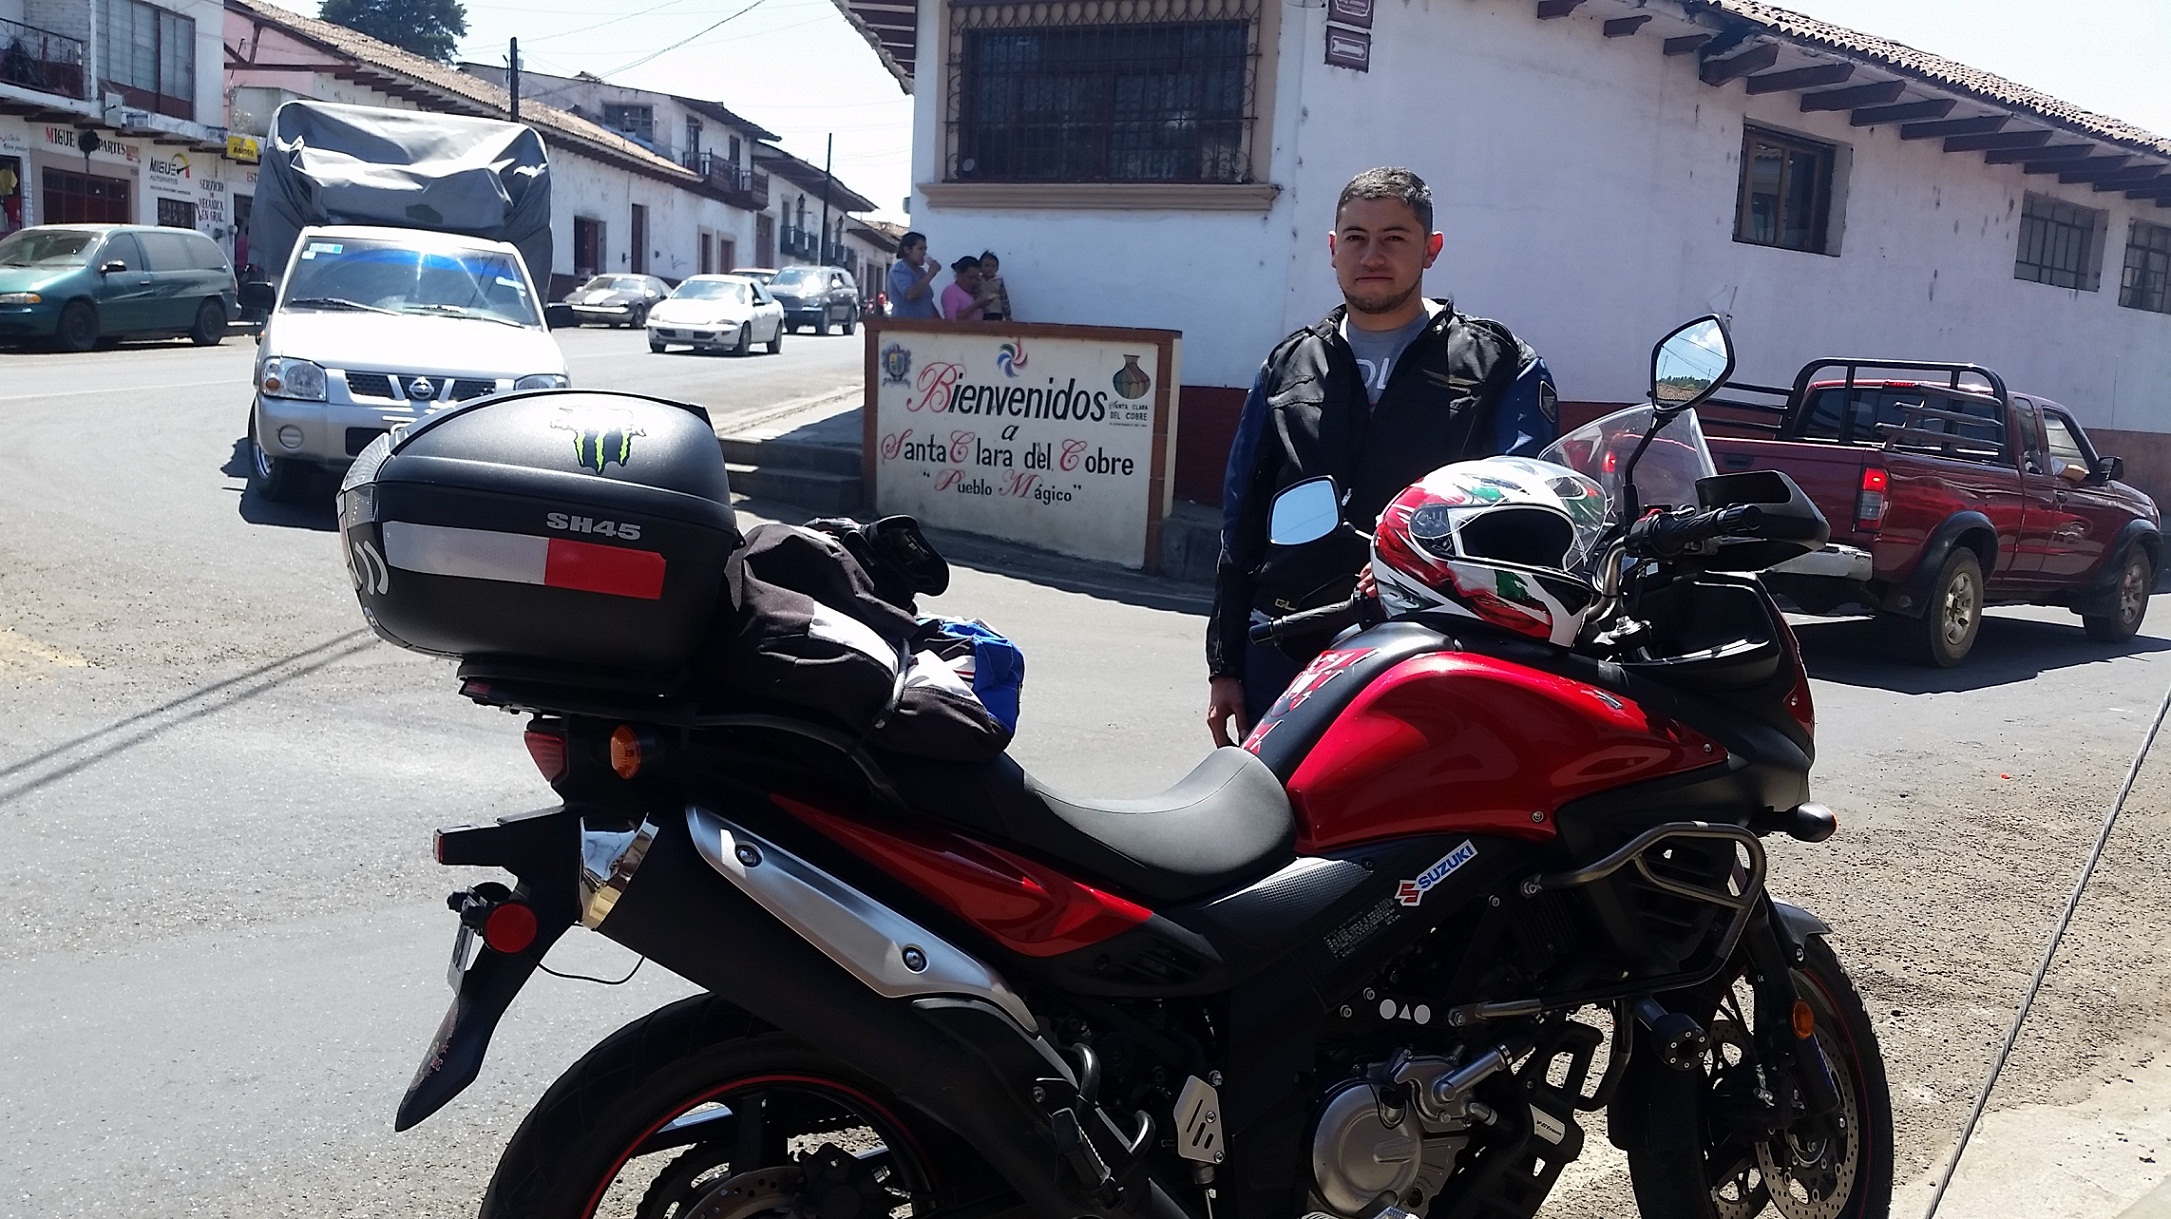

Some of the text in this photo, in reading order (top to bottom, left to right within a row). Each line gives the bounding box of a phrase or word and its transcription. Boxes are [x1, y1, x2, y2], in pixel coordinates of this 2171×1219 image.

[907, 362, 1108, 422] Bienvenidos
[1109, 401, 1128, 410] SANTA
[1110, 411, 1147, 421] DEL COBRE
[1001, 424, 1019, 441] a
[881, 429, 1134, 475] Santa Clara del Cobre
[546, 512, 641, 540] SH45
[1418, 845, 1474, 889] SUZUKI
